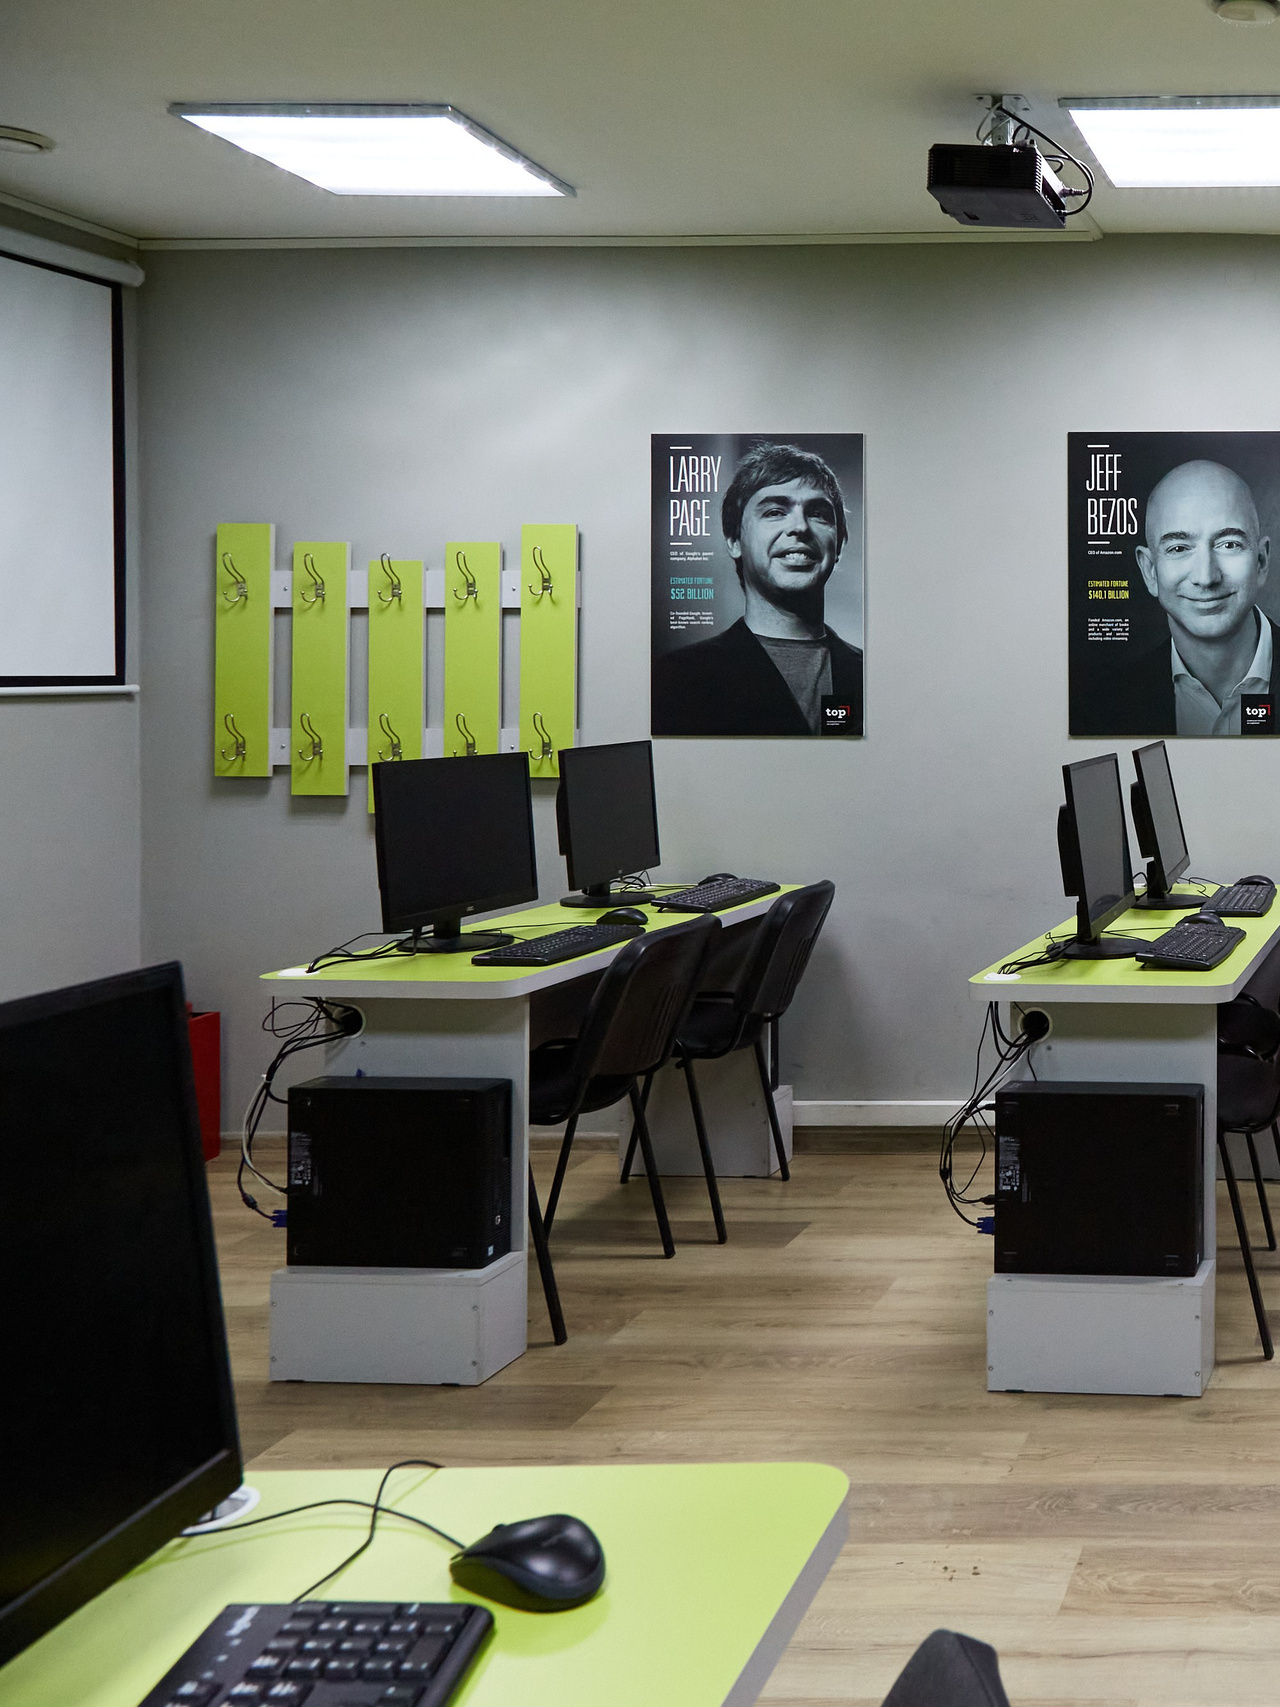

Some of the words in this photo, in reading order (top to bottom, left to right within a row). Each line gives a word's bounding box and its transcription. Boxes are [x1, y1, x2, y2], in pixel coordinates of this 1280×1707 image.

[670, 456, 721, 492] LARRY
[1086, 454, 1122, 491] JEFF
[670, 500, 710, 536] PAGE
[1088, 498, 1138, 535] BEZOS
[671, 588, 685, 599] $52
[687, 588, 714, 599] BILLION
[1108, 590, 1129, 600] BILLION
[826, 708, 847, 719] top
[1246, 706, 1267, 718] top
